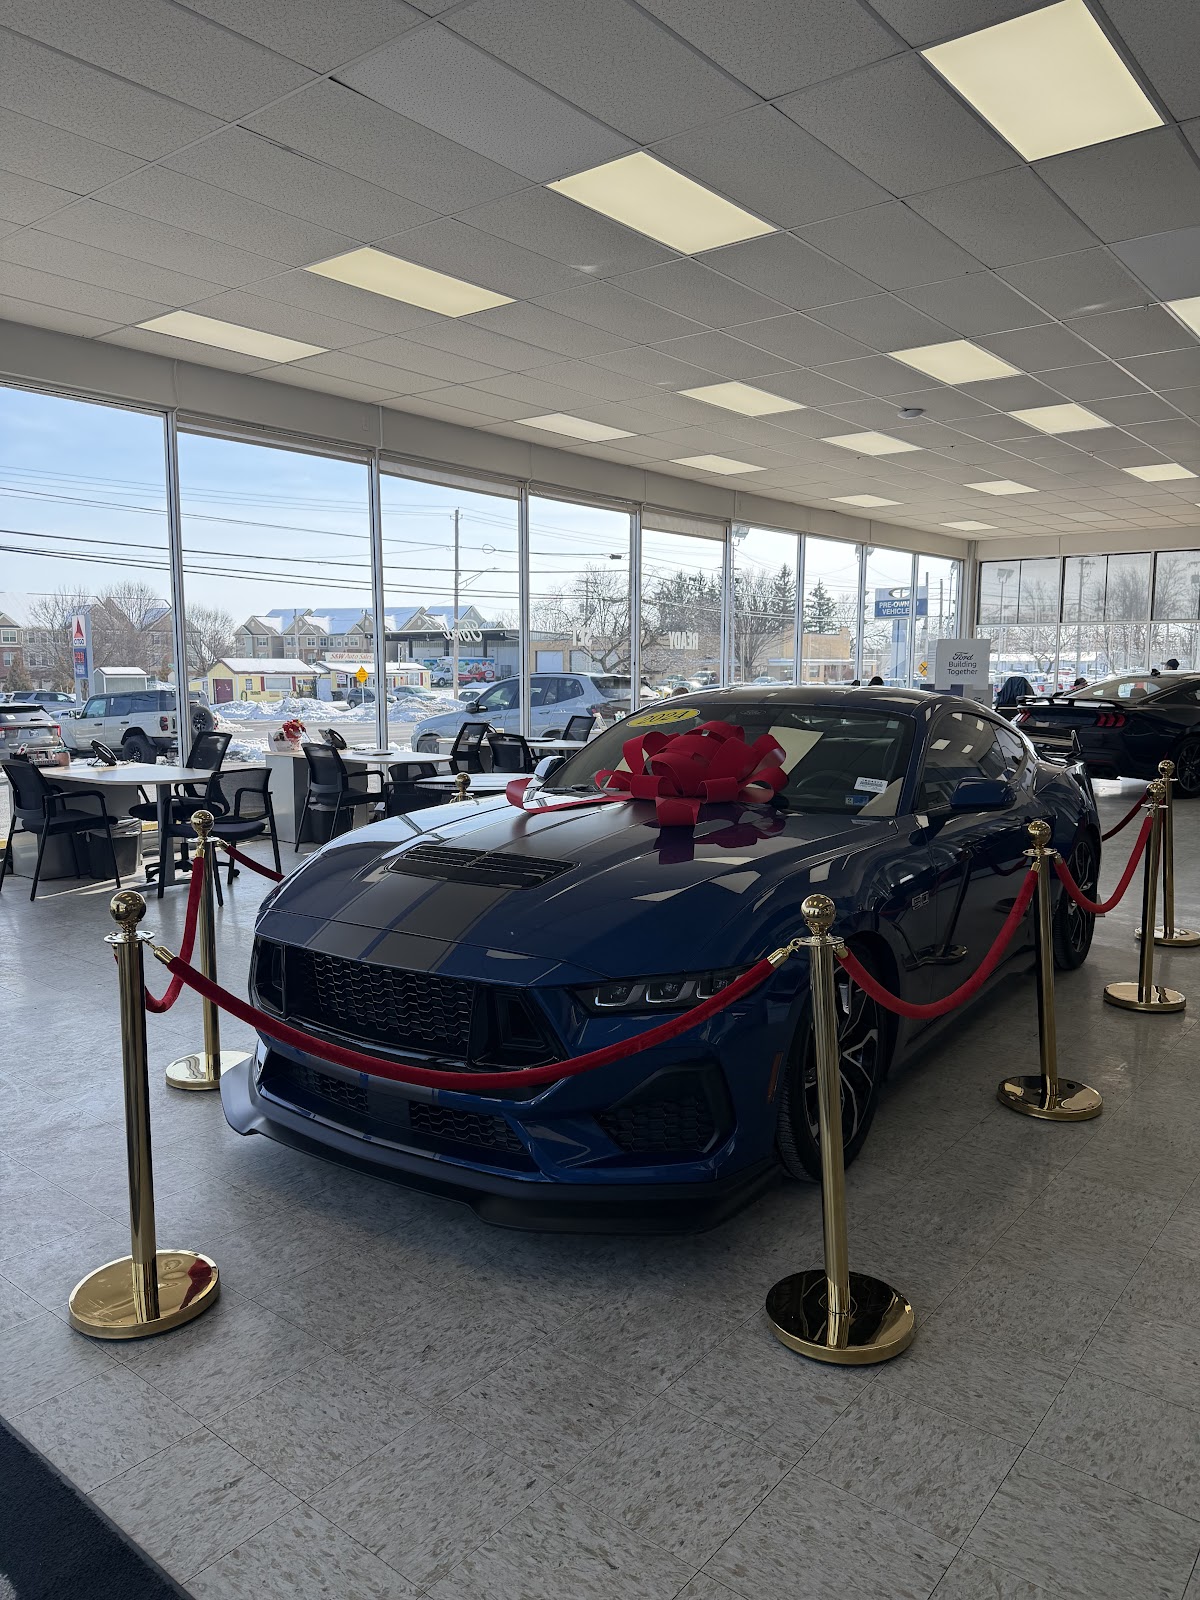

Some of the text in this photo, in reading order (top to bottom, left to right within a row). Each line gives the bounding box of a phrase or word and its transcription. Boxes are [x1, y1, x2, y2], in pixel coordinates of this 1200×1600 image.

[879, 601, 919, 609] PRE-OWN
[952, 651, 975, 661] Ford
[948, 661, 977, 669] Building
[947, 668, 979, 677] Together
[636, 710, 691, 725] 2024
